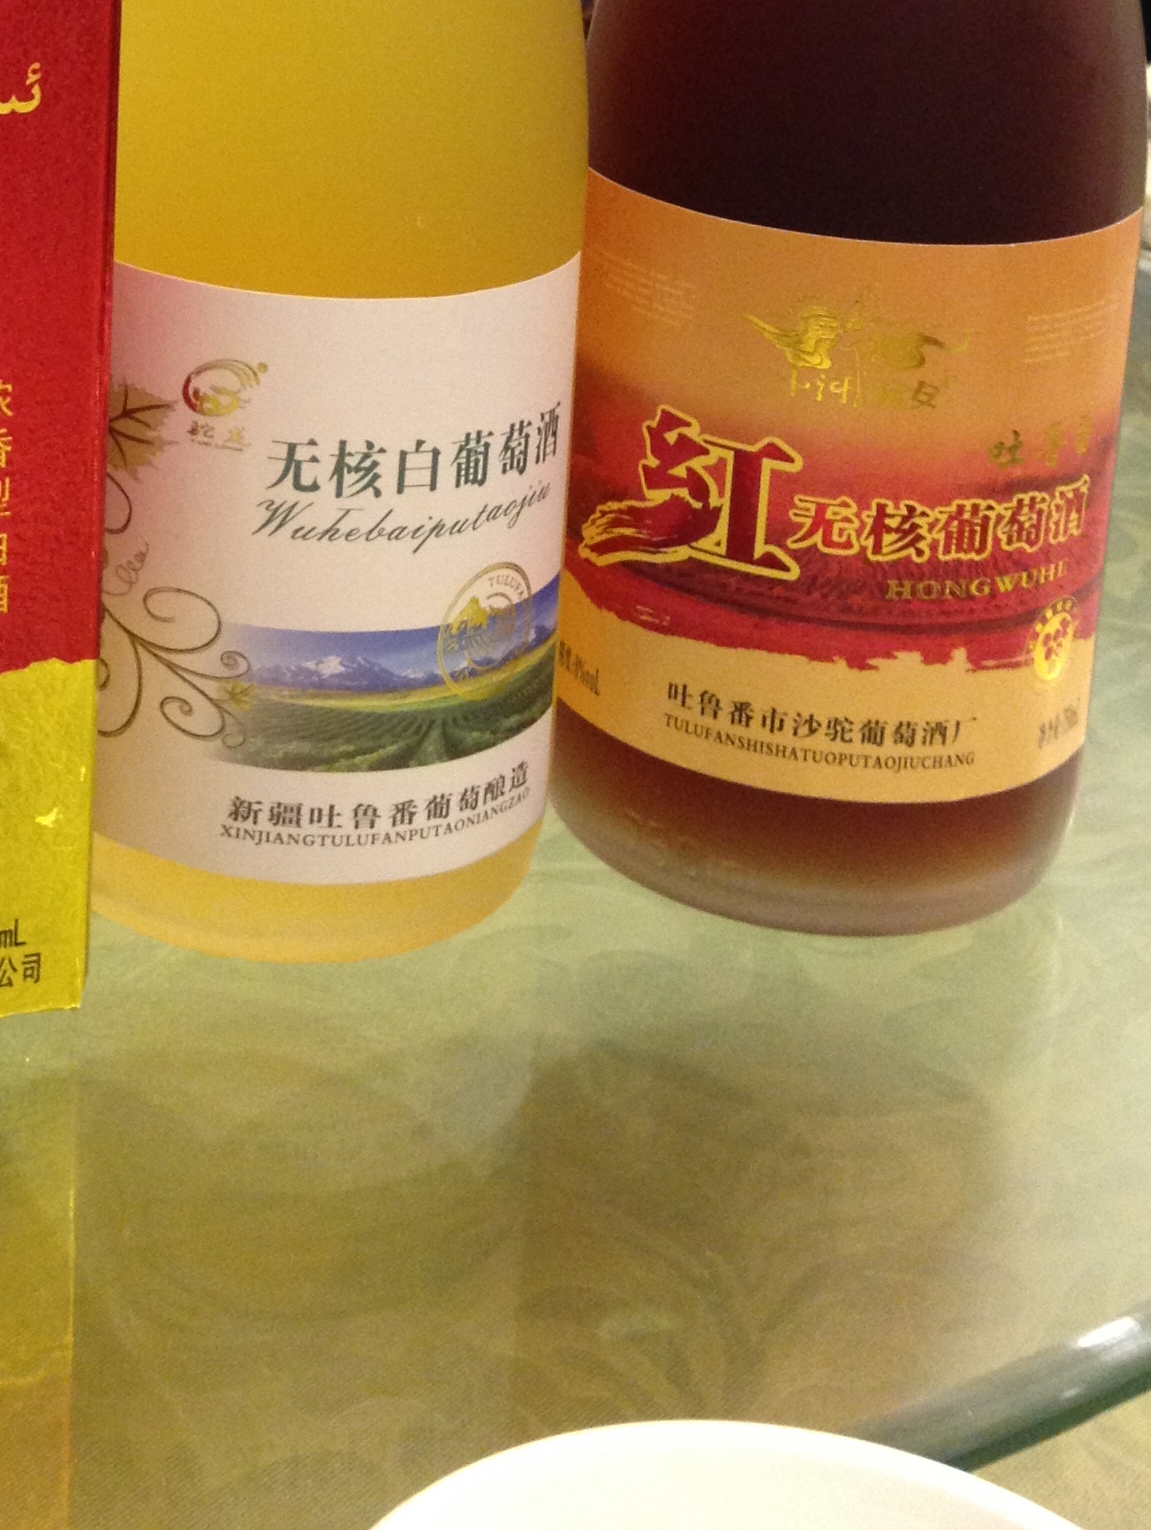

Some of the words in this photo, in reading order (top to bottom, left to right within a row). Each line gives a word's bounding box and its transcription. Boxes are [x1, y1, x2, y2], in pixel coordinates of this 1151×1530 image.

[265, 400, 562, 500] 无核白葡萄酒
[251, 480, 552, 554] Wuhebaiputaojiu
[579, 405, 804, 582] 红
[787, 474, 1091, 563] 无核葡萄酒
[664, 712, 976, 773] TULUFANSHISHATUOPUTAOJIUCHANG
[667, 681, 977, 749] 吐鲁番市沙驼葡萄酒厂
[219, 786, 532, 847] XINJIANGTULUFANPUTAONIANGZAO
[227, 759, 530, 830] 新疆吐鲁番葡萄酿造
